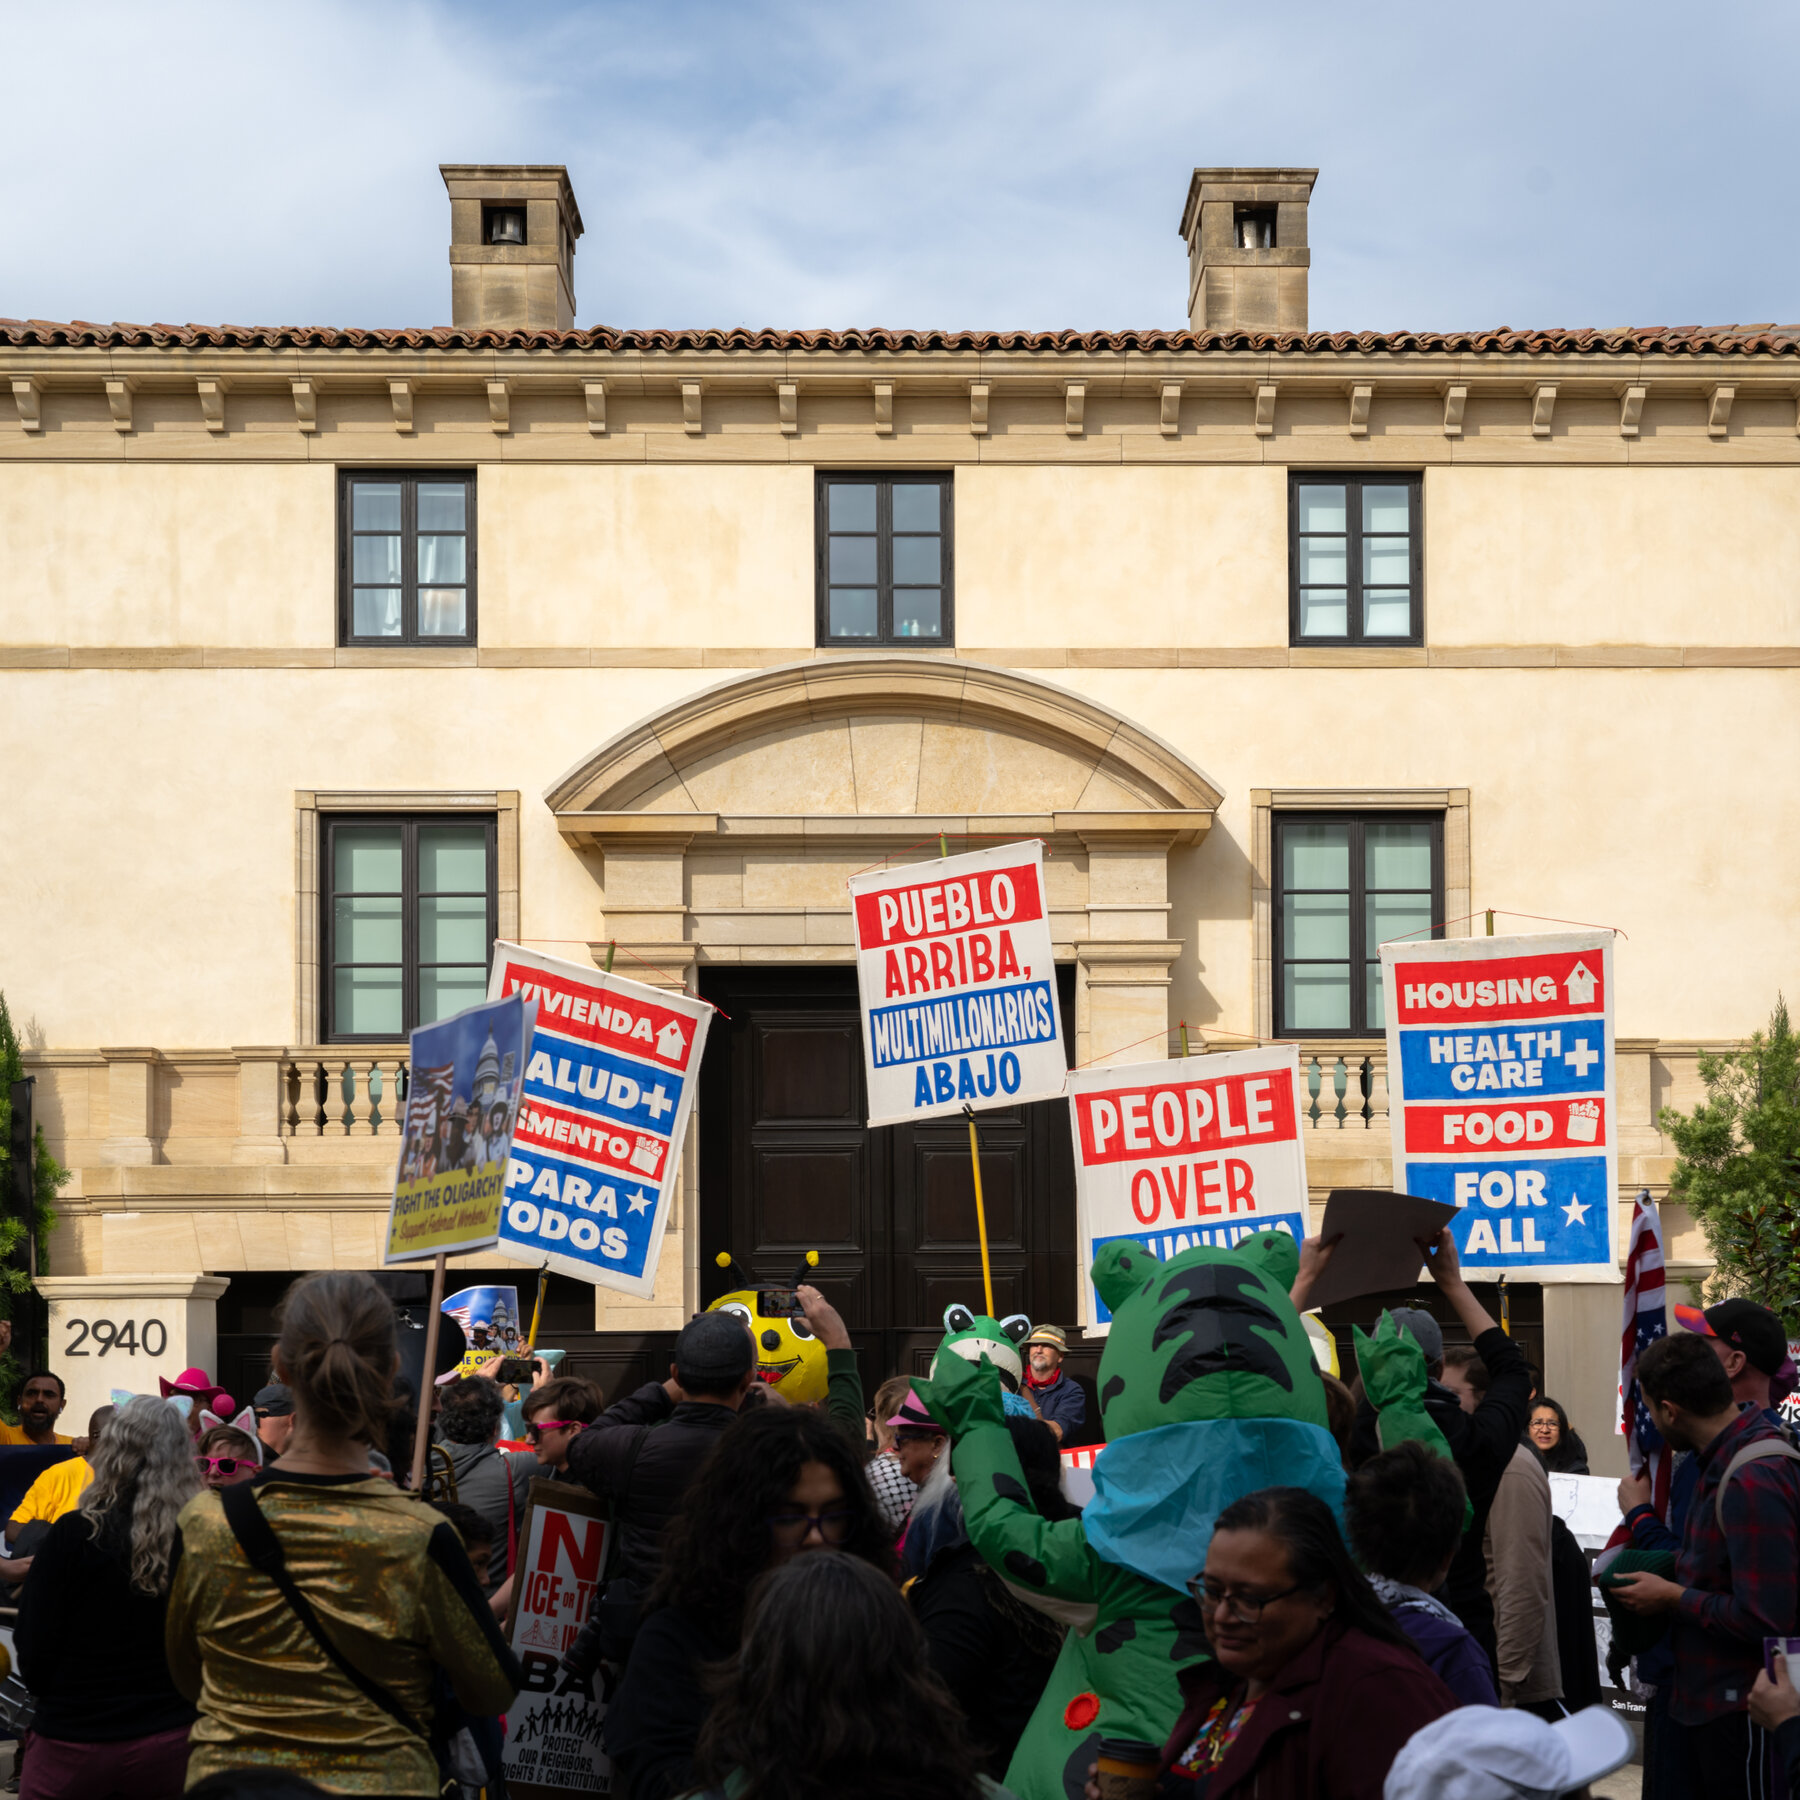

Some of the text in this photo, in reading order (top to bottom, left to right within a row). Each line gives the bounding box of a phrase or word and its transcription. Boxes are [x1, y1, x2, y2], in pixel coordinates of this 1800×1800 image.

[878, 873, 1016, 942] PUEBLO
[885, 929, 1032, 999] ARRIBA,
[1403, 975, 1558, 1009] HOUSING
[873, 986, 1052, 1064] MULTIMILLONARIOS
[1429, 1030, 1561, 1064] HEALTH
[525, 1050, 640, 1110] ALUD
[914, 1051, 1022, 1108] ABAJO
[1450, 1059, 1543, 1092] CARE
[516, 1107, 630, 1159] IMENTO
[1089, 1078, 1275, 1155] PEOPLE
[1443, 1110, 1554, 1145] FOOD
[393, 1173, 504, 1217] FIGHT THE OLIGARCHY
[505, 1157, 618, 1219] PARA
[1131, 1158, 1256, 1226] OVER
[1454, 1169, 1548, 1209] FOR
[400, 1216, 428, 1244] Support
[428, 1210, 458, 1234] Federal
[1464, 1217, 1546, 1254] ALL
[65, 1318, 168, 1357] 2940
[537, 1510, 606, 1583] N
[523, 1571, 563, 1618] ICE
[562, 1591, 575, 1609] OR
[1612, 1699, 1626, 1710] San
[519, 1748, 594, 1773] OUR NEIGHBORS,
[541, 1735, 584, 1754] PROTECT
[536, 1767, 544, 1782] &
[545, 1769, 610, 1791] CONSTITUTION
